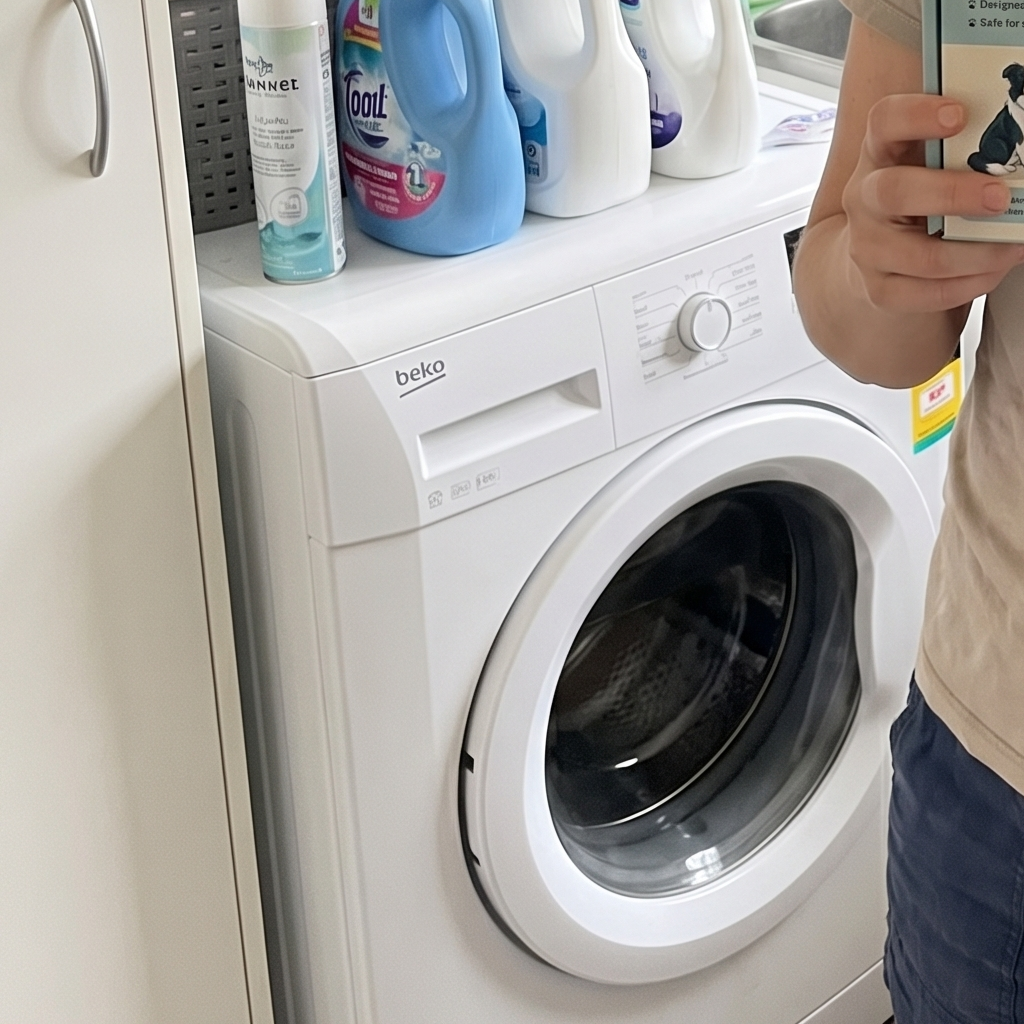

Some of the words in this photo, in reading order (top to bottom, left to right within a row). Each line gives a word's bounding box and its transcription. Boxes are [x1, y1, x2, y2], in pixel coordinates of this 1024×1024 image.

[979, 17, 1003, 28] Safe
[1005, 17, 1020, 28] for
[395, 360, 446, 386] beko
